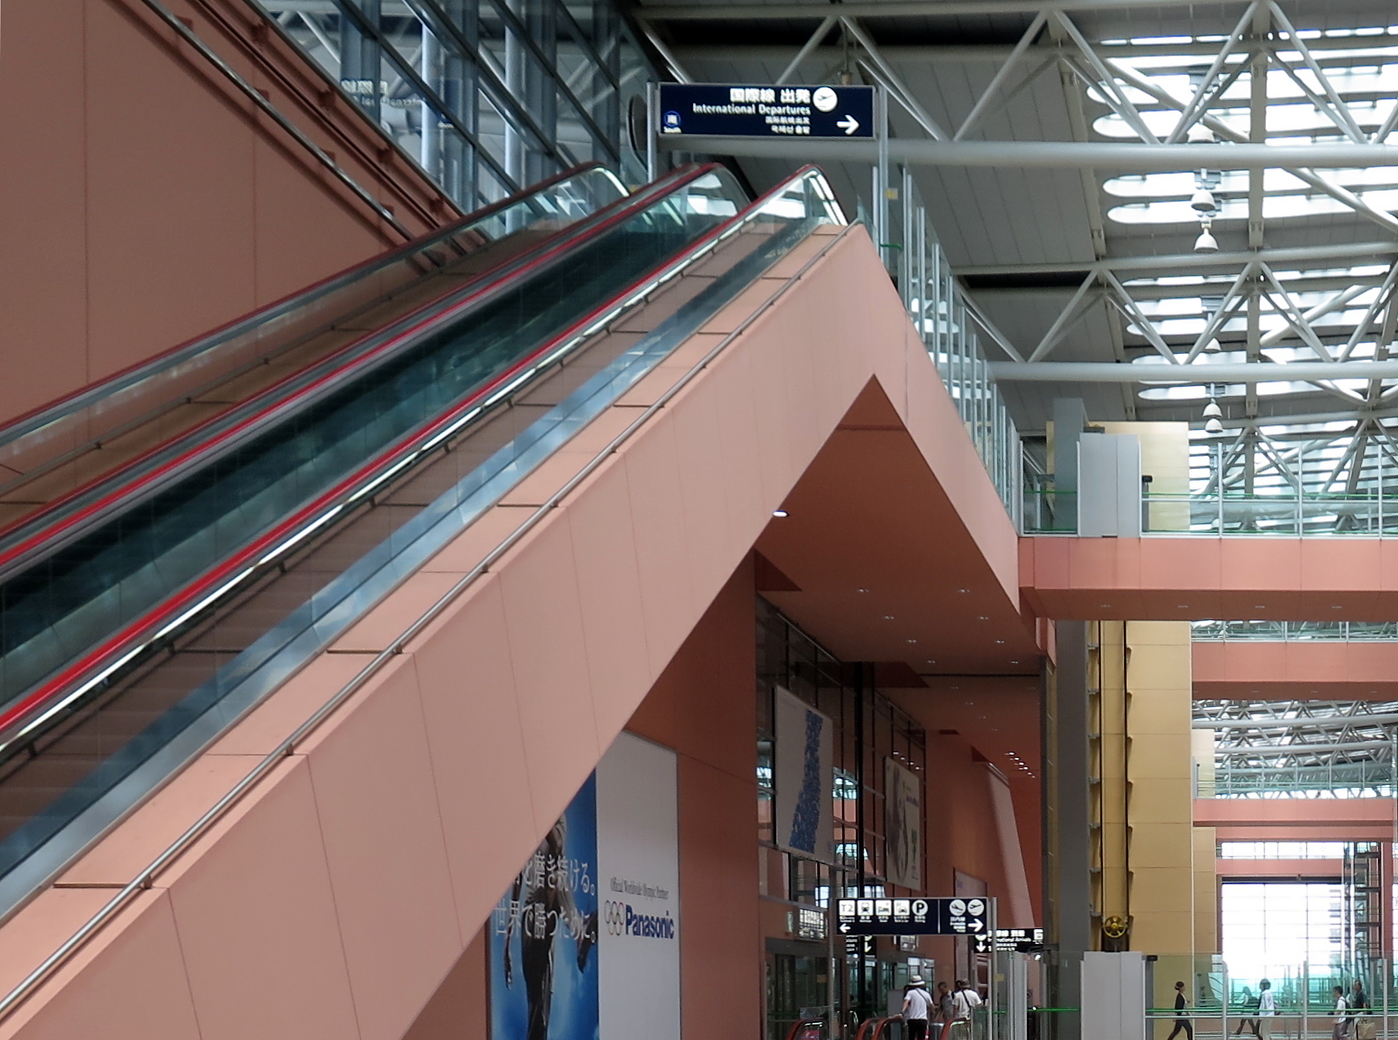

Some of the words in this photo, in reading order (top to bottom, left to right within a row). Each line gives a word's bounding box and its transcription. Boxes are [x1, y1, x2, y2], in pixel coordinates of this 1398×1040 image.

[730, 88, 775, 103] 国際線
[780, 88, 811, 104] 出発
[692, 102, 756, 115] International
[758, 103, 811, 117] Departures
[625, 904, 675, 940] Panasonic
